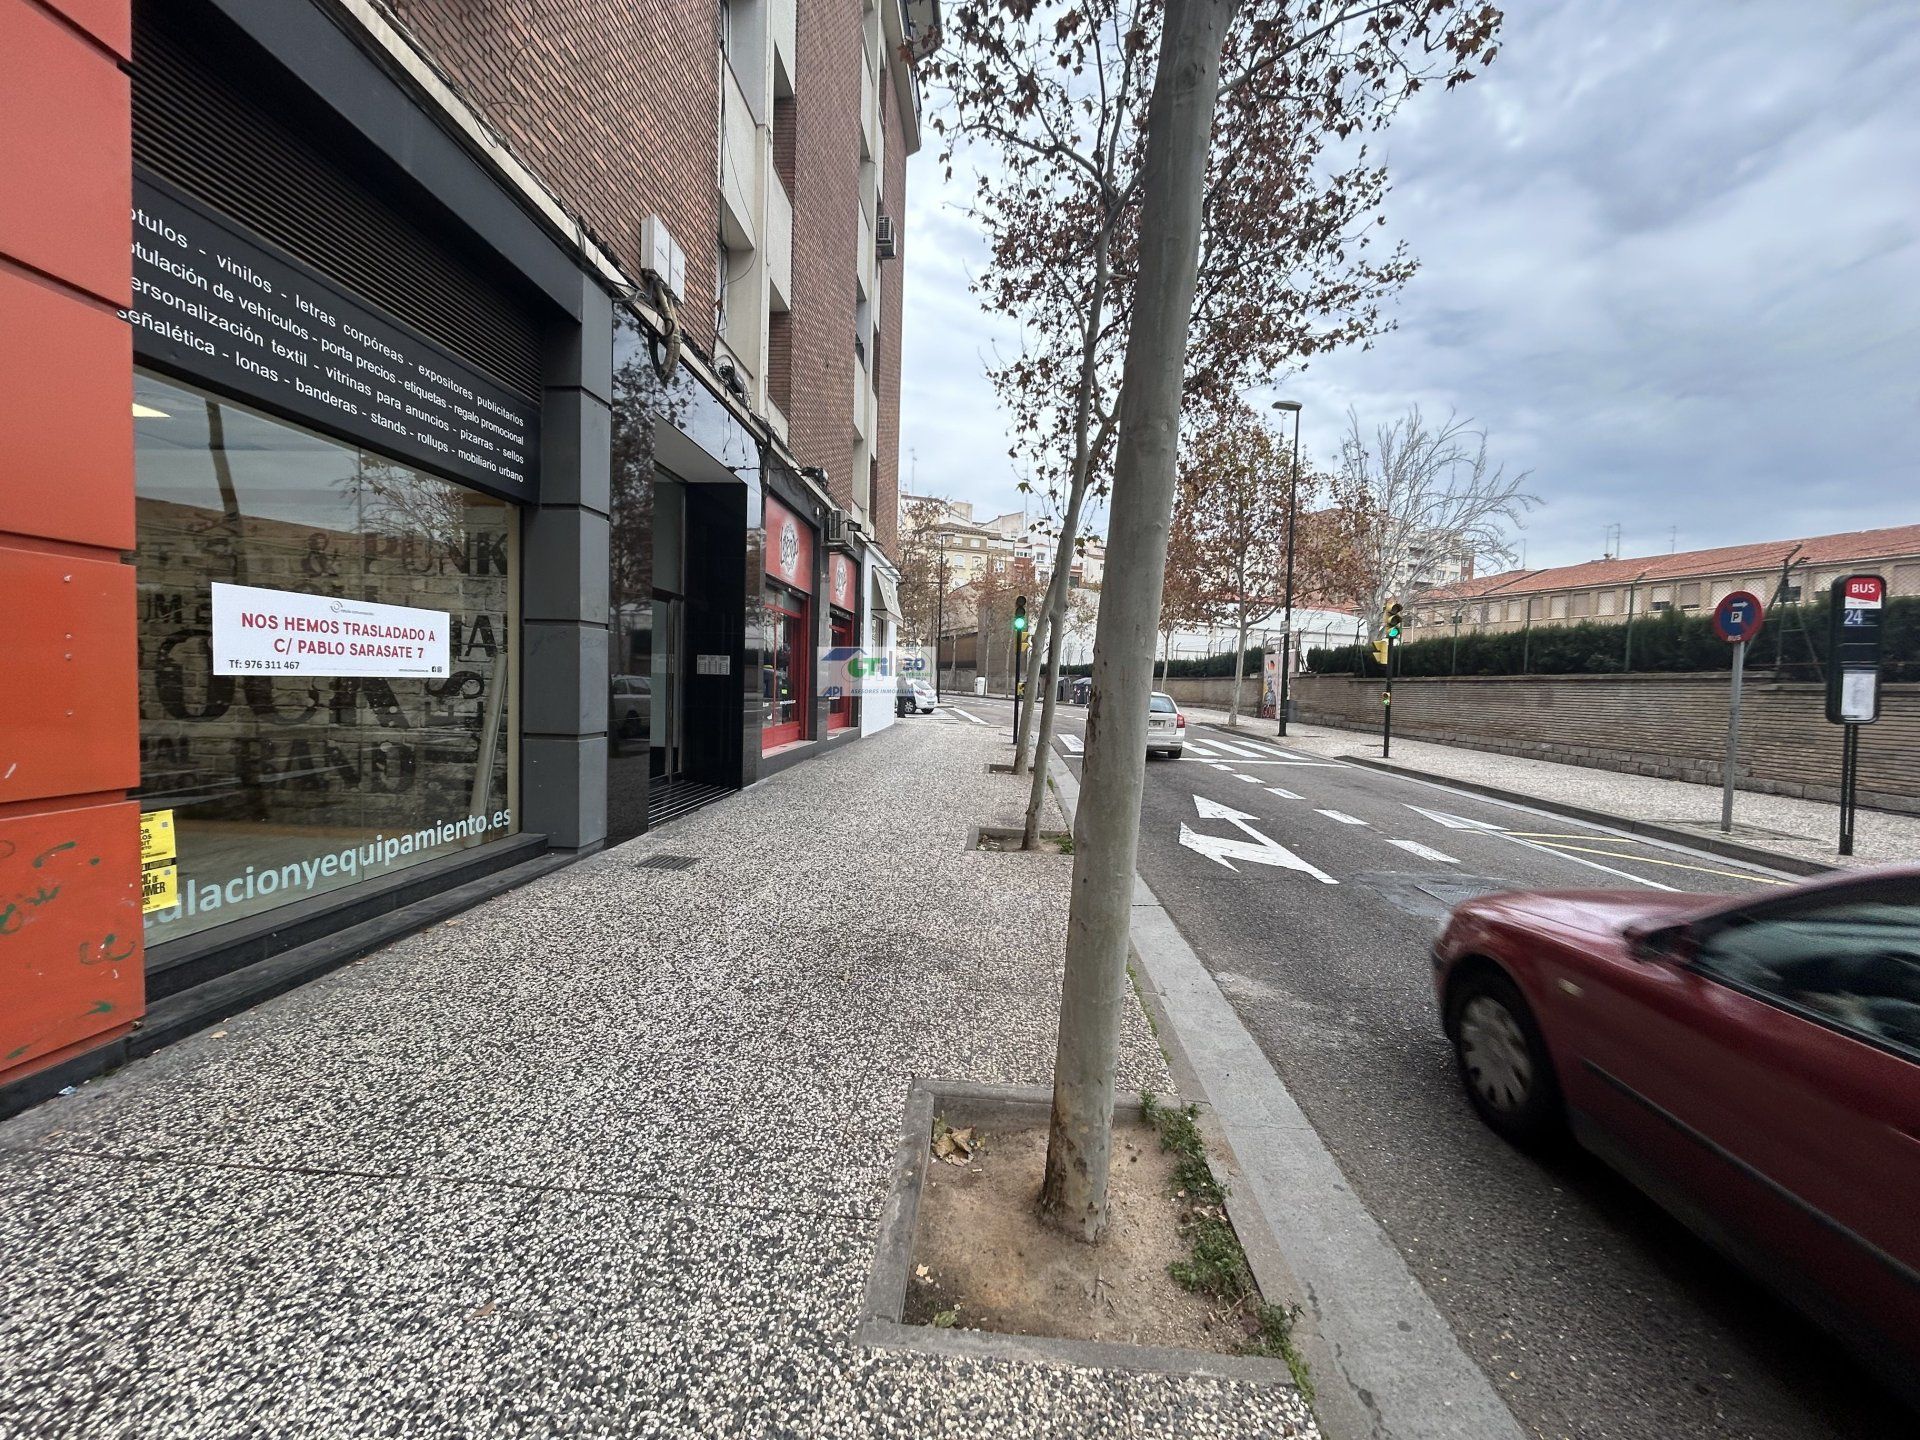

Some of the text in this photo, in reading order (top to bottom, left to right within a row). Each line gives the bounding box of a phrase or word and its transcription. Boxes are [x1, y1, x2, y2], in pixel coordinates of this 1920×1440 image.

[131, 241, 208, 291] tulación
[213, 283, 234, 303] de
[322, 338, 353, 362] porta
[356, 355, 396, 384] precios
[404, 380, 447, 408] etiquetas
[454, 404, 480, 424] regalo
[480, 418, 524, 446] promocional
[217, 254, 272, 293] vinilos
[296, 294, 336, 328] letras
[343, 324, 404, 364] corpóreas
[418, 364, 473, 400] expositores
[477, 395, 524, 427] publicitarios
[236, 350, 279, 382] lonas
[296, 377, 358, 415] banderas
[370, 412, 407, 436] stands
[417, 432, 448, 453] rollups
[458, 448, 497, 472] mobiliario
[498, 466, 524, 483] urbano
[271, 338, 308, 367] textil
[326, 366, 372, 396] vitrinas
[376, 390, 401, 410] para
[405, 404, 449, 432] anuncios
[460, 428, 494, 451] pizarras
[502, 448, 524, 464] sellos
[1844, 610, 1862, 625] 24
[1852, 584, 1876, 594] BUS
[229, 659, 242, 669] Tf:
[244, 660, 262, 670] 976
[264, 660, 281, 670] 311
[283, 661, 300, 670] 467
[241, 612, 279, 630] NOS
[284, 616, 340, 634] HEMOS
[343, 622, 425, 642] TRASLADADO
[428, 630, 436, 642] A
[274, 638, 424, 659] C/ PABLO SARASATE 7
[143, 808, 511, 929] ulacionyequipamiento.es
